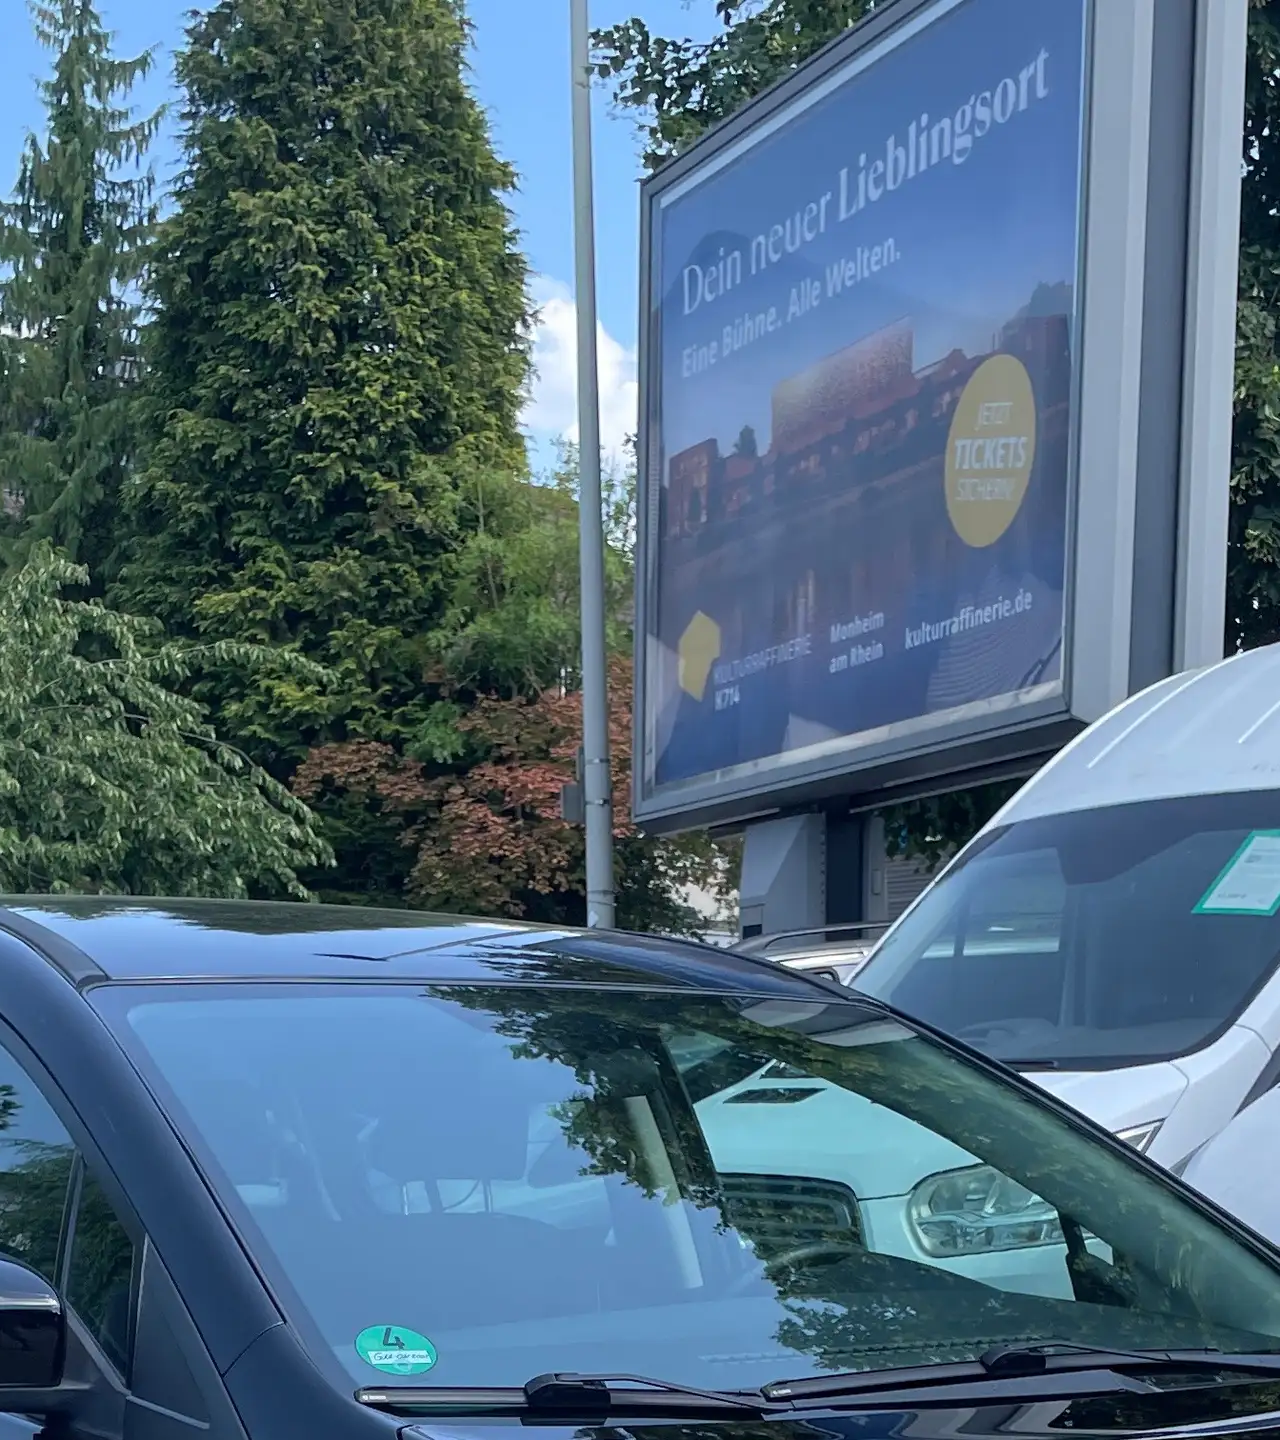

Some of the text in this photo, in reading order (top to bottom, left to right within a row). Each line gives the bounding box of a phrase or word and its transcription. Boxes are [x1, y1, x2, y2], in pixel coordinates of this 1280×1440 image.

[683, 47, 1050, 316] Dein neuer Lieblingsort
[682, 237, 901, 378] Eine Bühne. Alle Welten.
[954, 436, 1028, 470] TICKETS
[830, 611, 885, 643] Monheim
[905, 588, 1033, 650] kulturraffinerie.de
[829, 640, 884, 673] am Rhein
